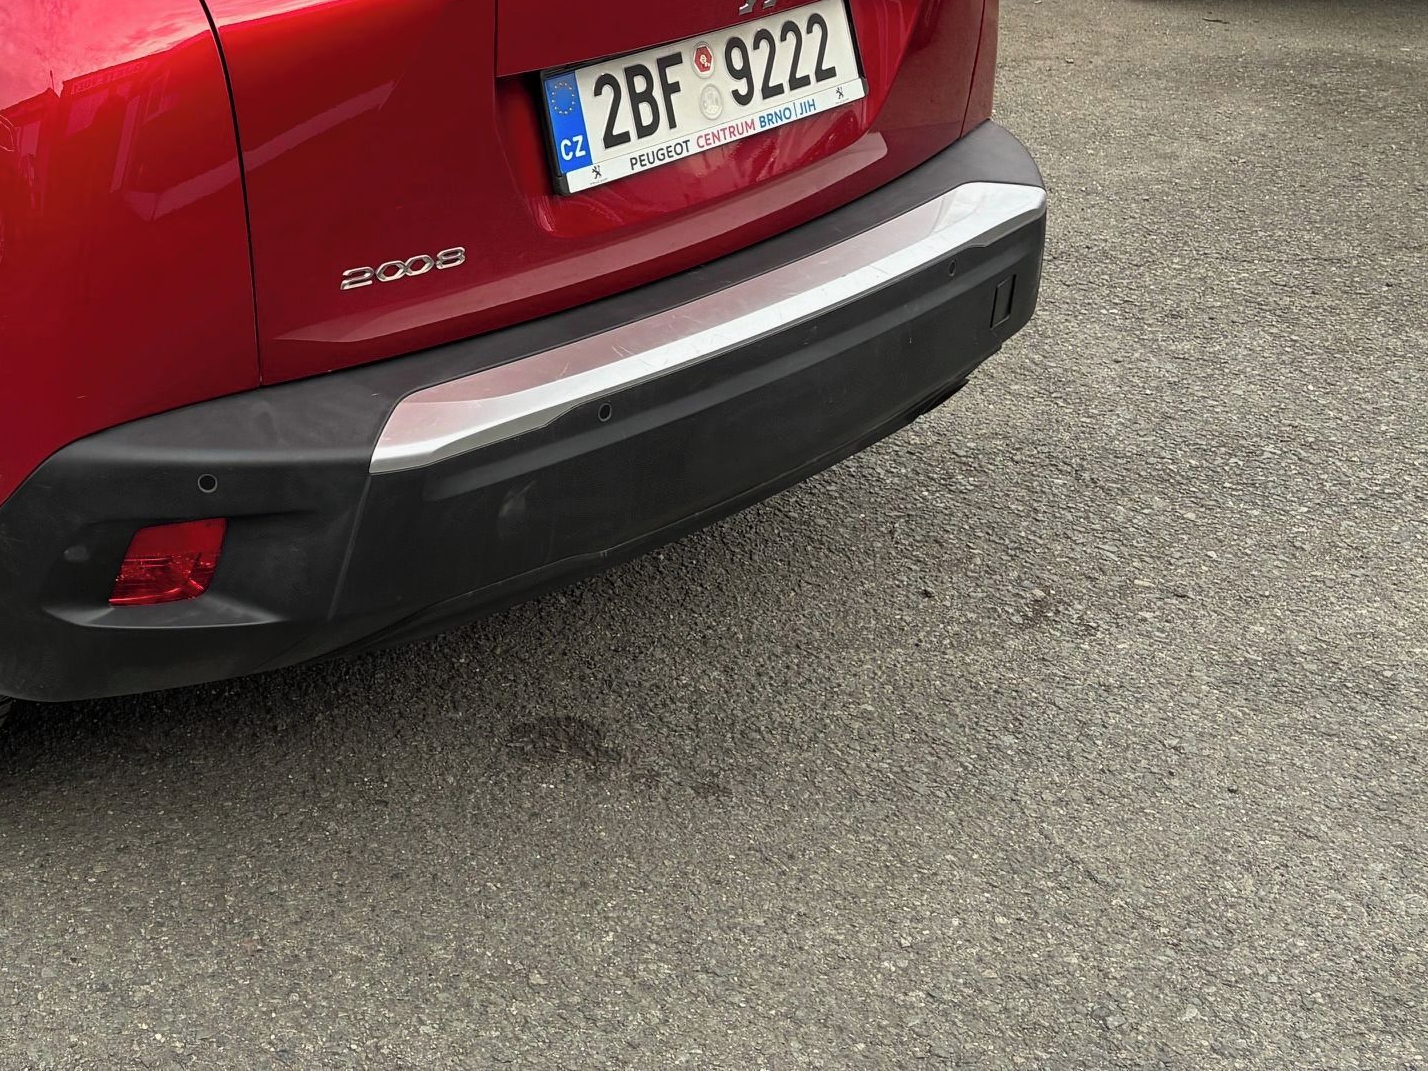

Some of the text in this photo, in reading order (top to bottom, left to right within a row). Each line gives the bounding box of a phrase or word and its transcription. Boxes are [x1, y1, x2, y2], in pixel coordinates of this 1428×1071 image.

[593, 13, 837, 150] 2BF 9222
[560, 137, 587, 161] CZ
[629, 139, 691, 171] PEUGEOT
[696, 118, 756, 149] CENTRUM
[340, 246, 466, 290] 2008
